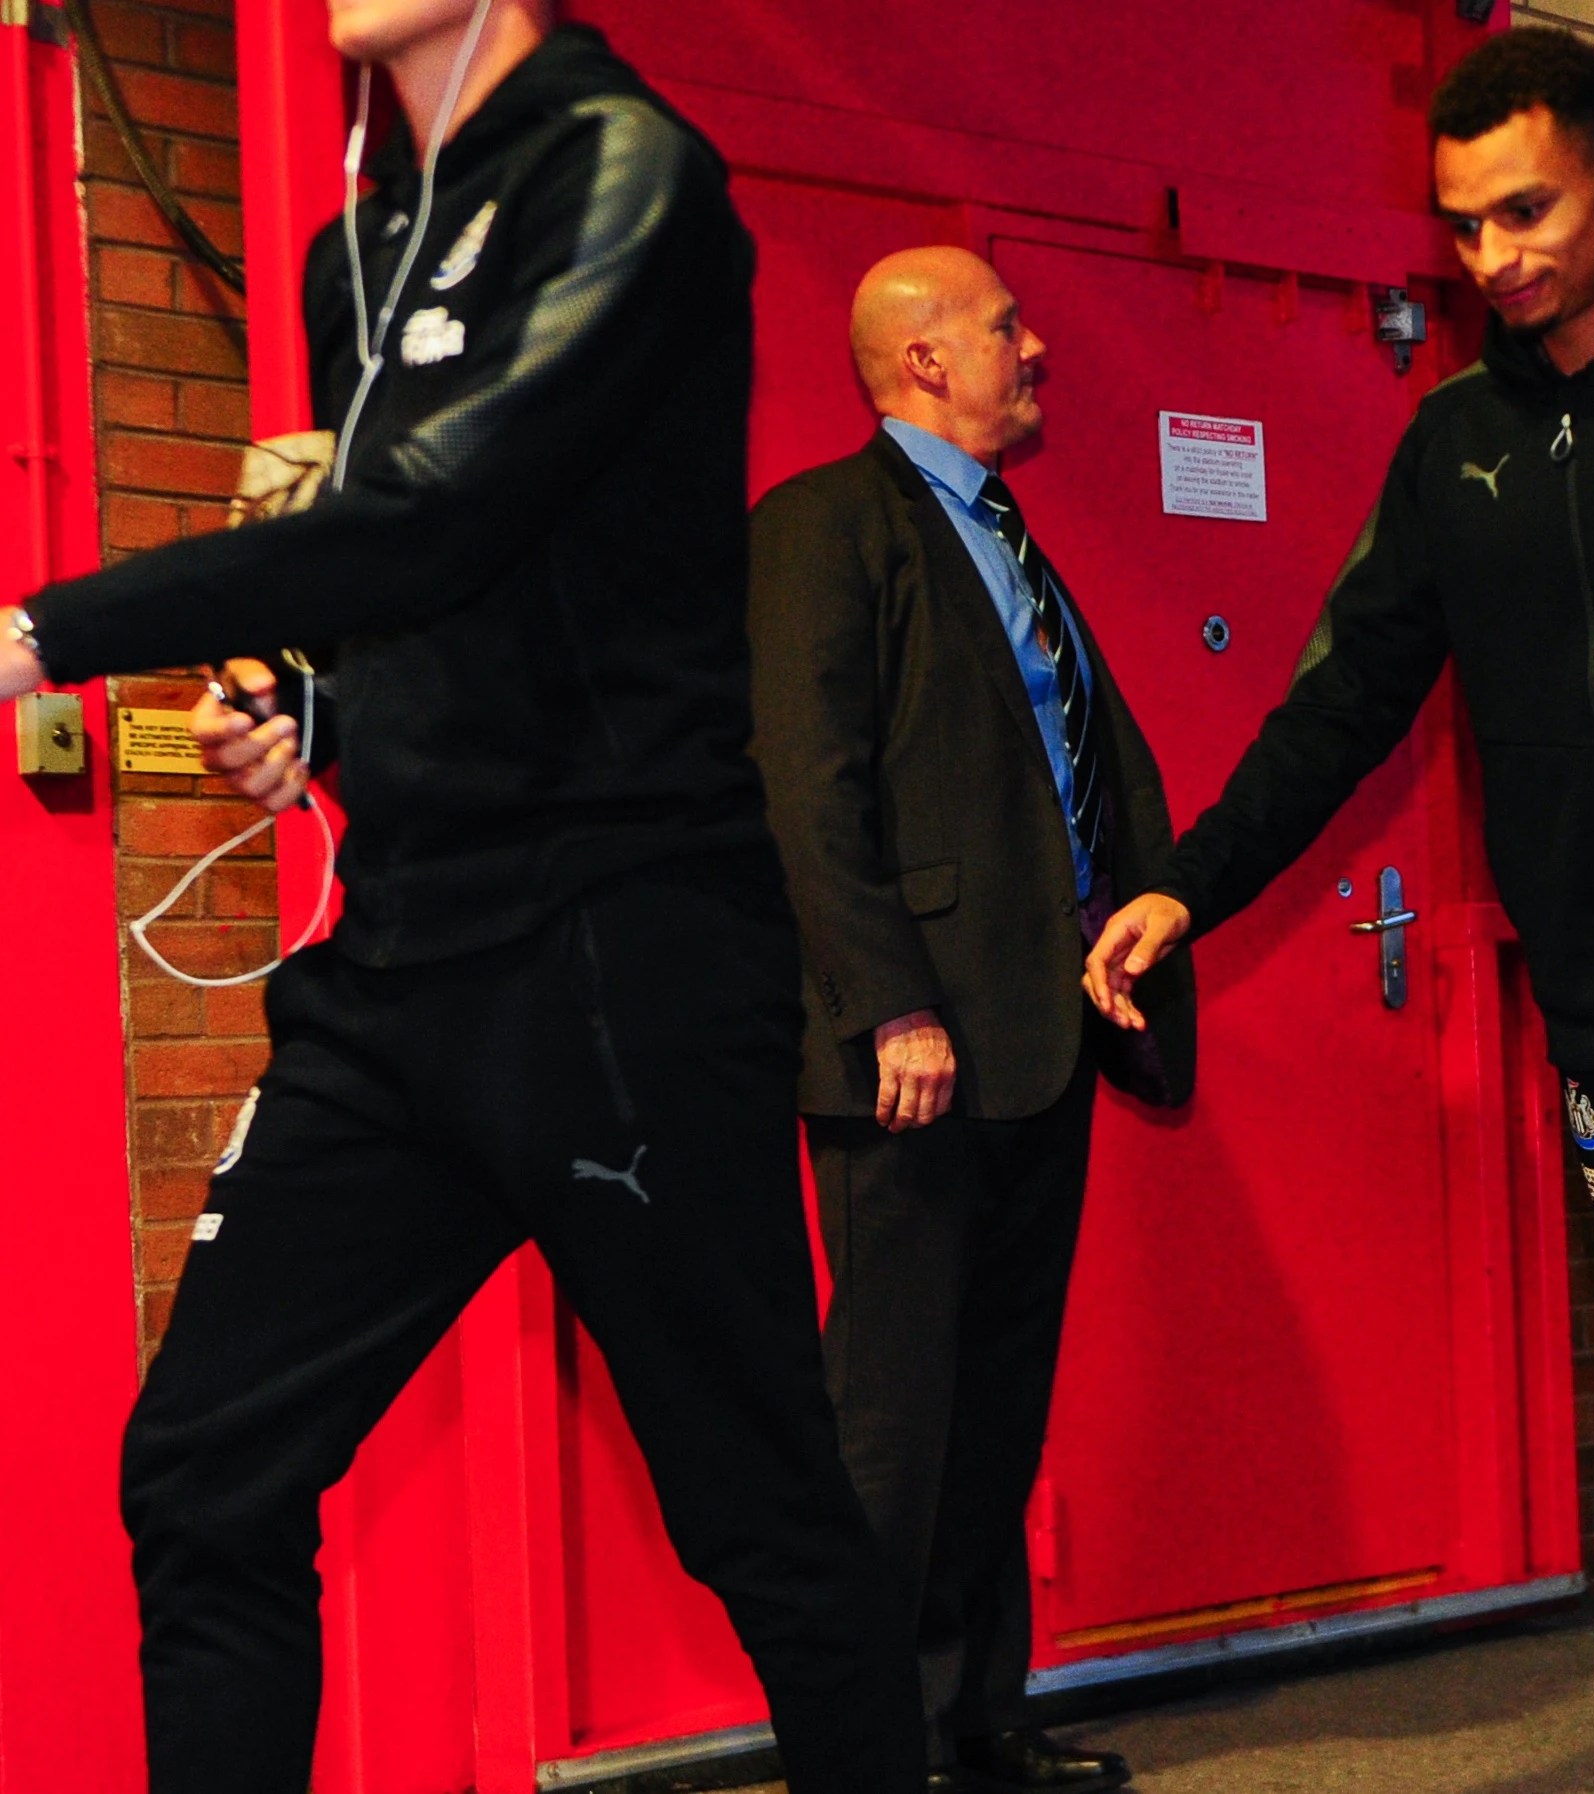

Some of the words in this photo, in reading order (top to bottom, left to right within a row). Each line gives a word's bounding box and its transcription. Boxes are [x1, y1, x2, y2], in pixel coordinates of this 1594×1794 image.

[1182, 419, 1189, 427] NO
[1190, 420, 1212, 430] RETURN
[1213, 423, 1241, 433] MATCHDAY
[1172, 428, 1191, 437] POLICY
[1192, 430, 1226, 441] RESPECTING
